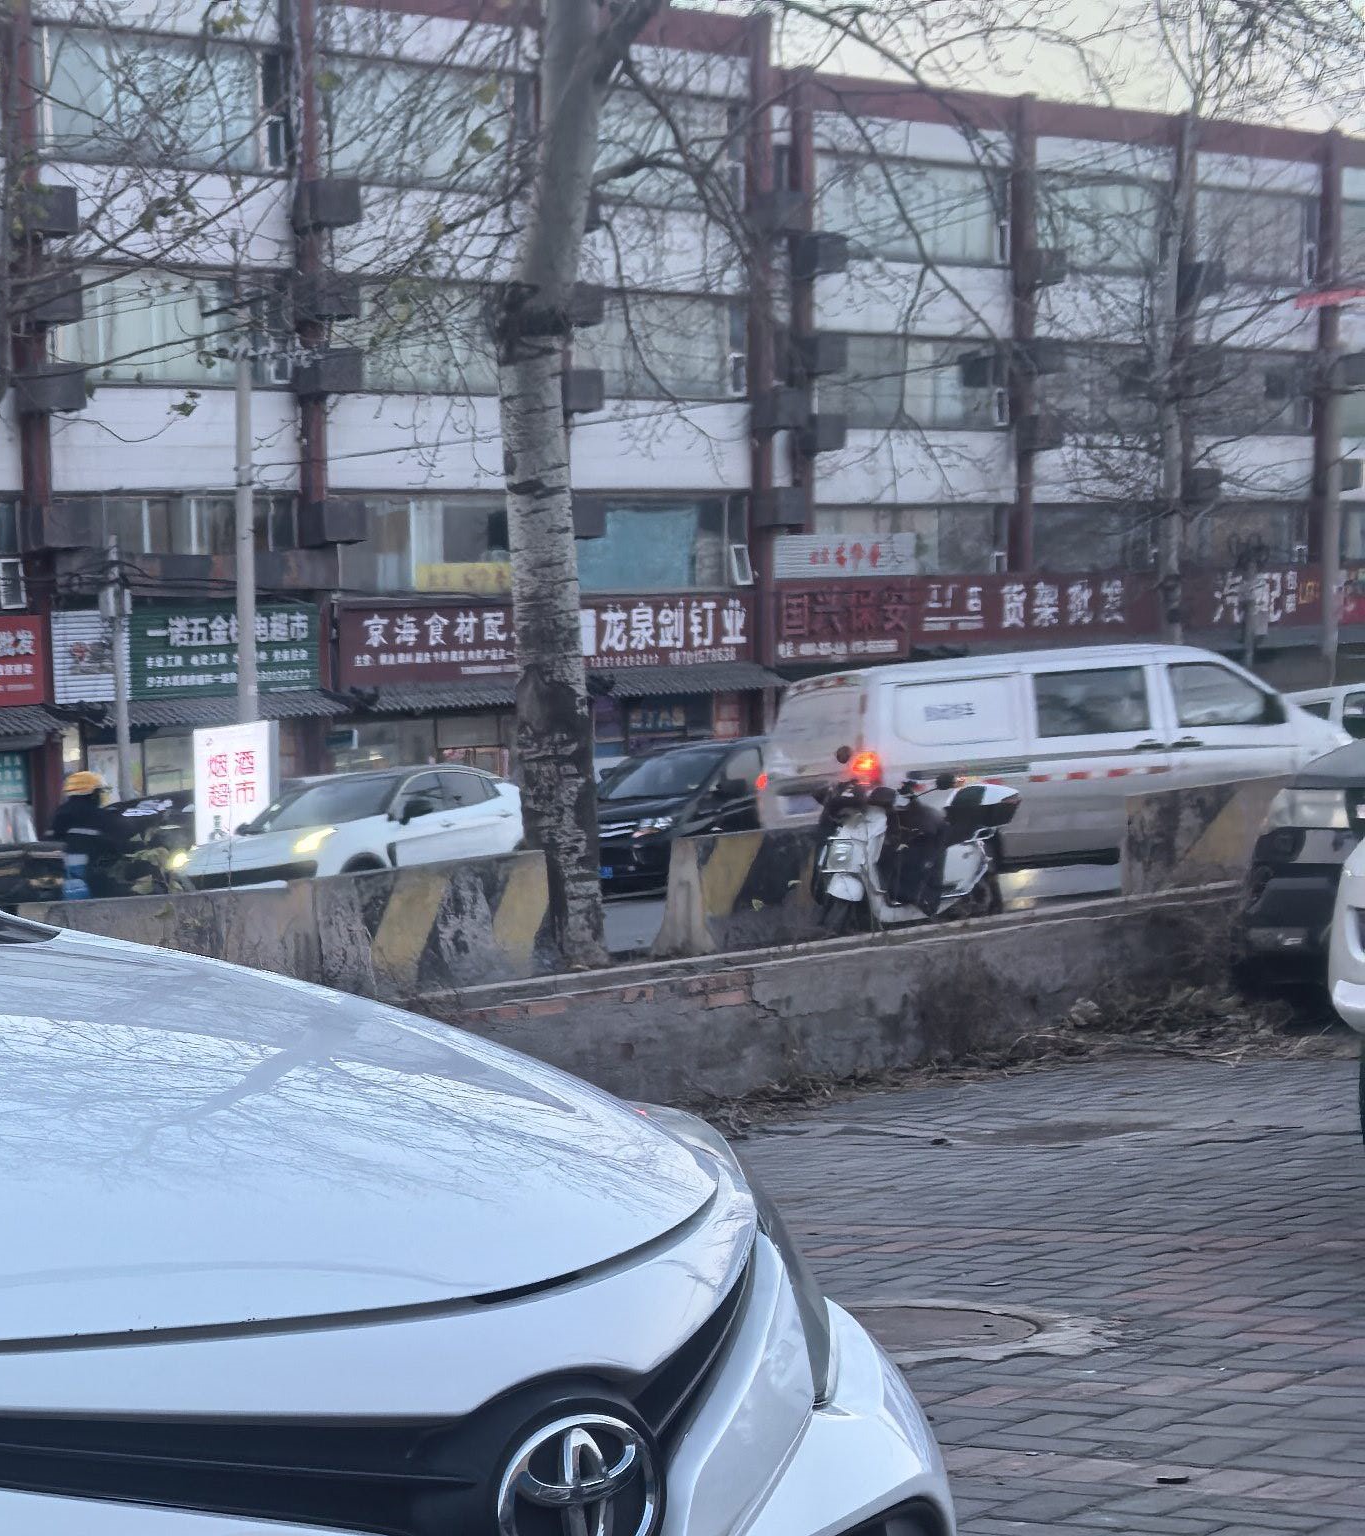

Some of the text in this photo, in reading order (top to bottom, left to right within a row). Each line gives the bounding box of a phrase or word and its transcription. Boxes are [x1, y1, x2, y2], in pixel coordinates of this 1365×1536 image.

[363, 611, 516, 648] 京海食材配
[600, 599, 746, 652] 龙泉剑钉业
